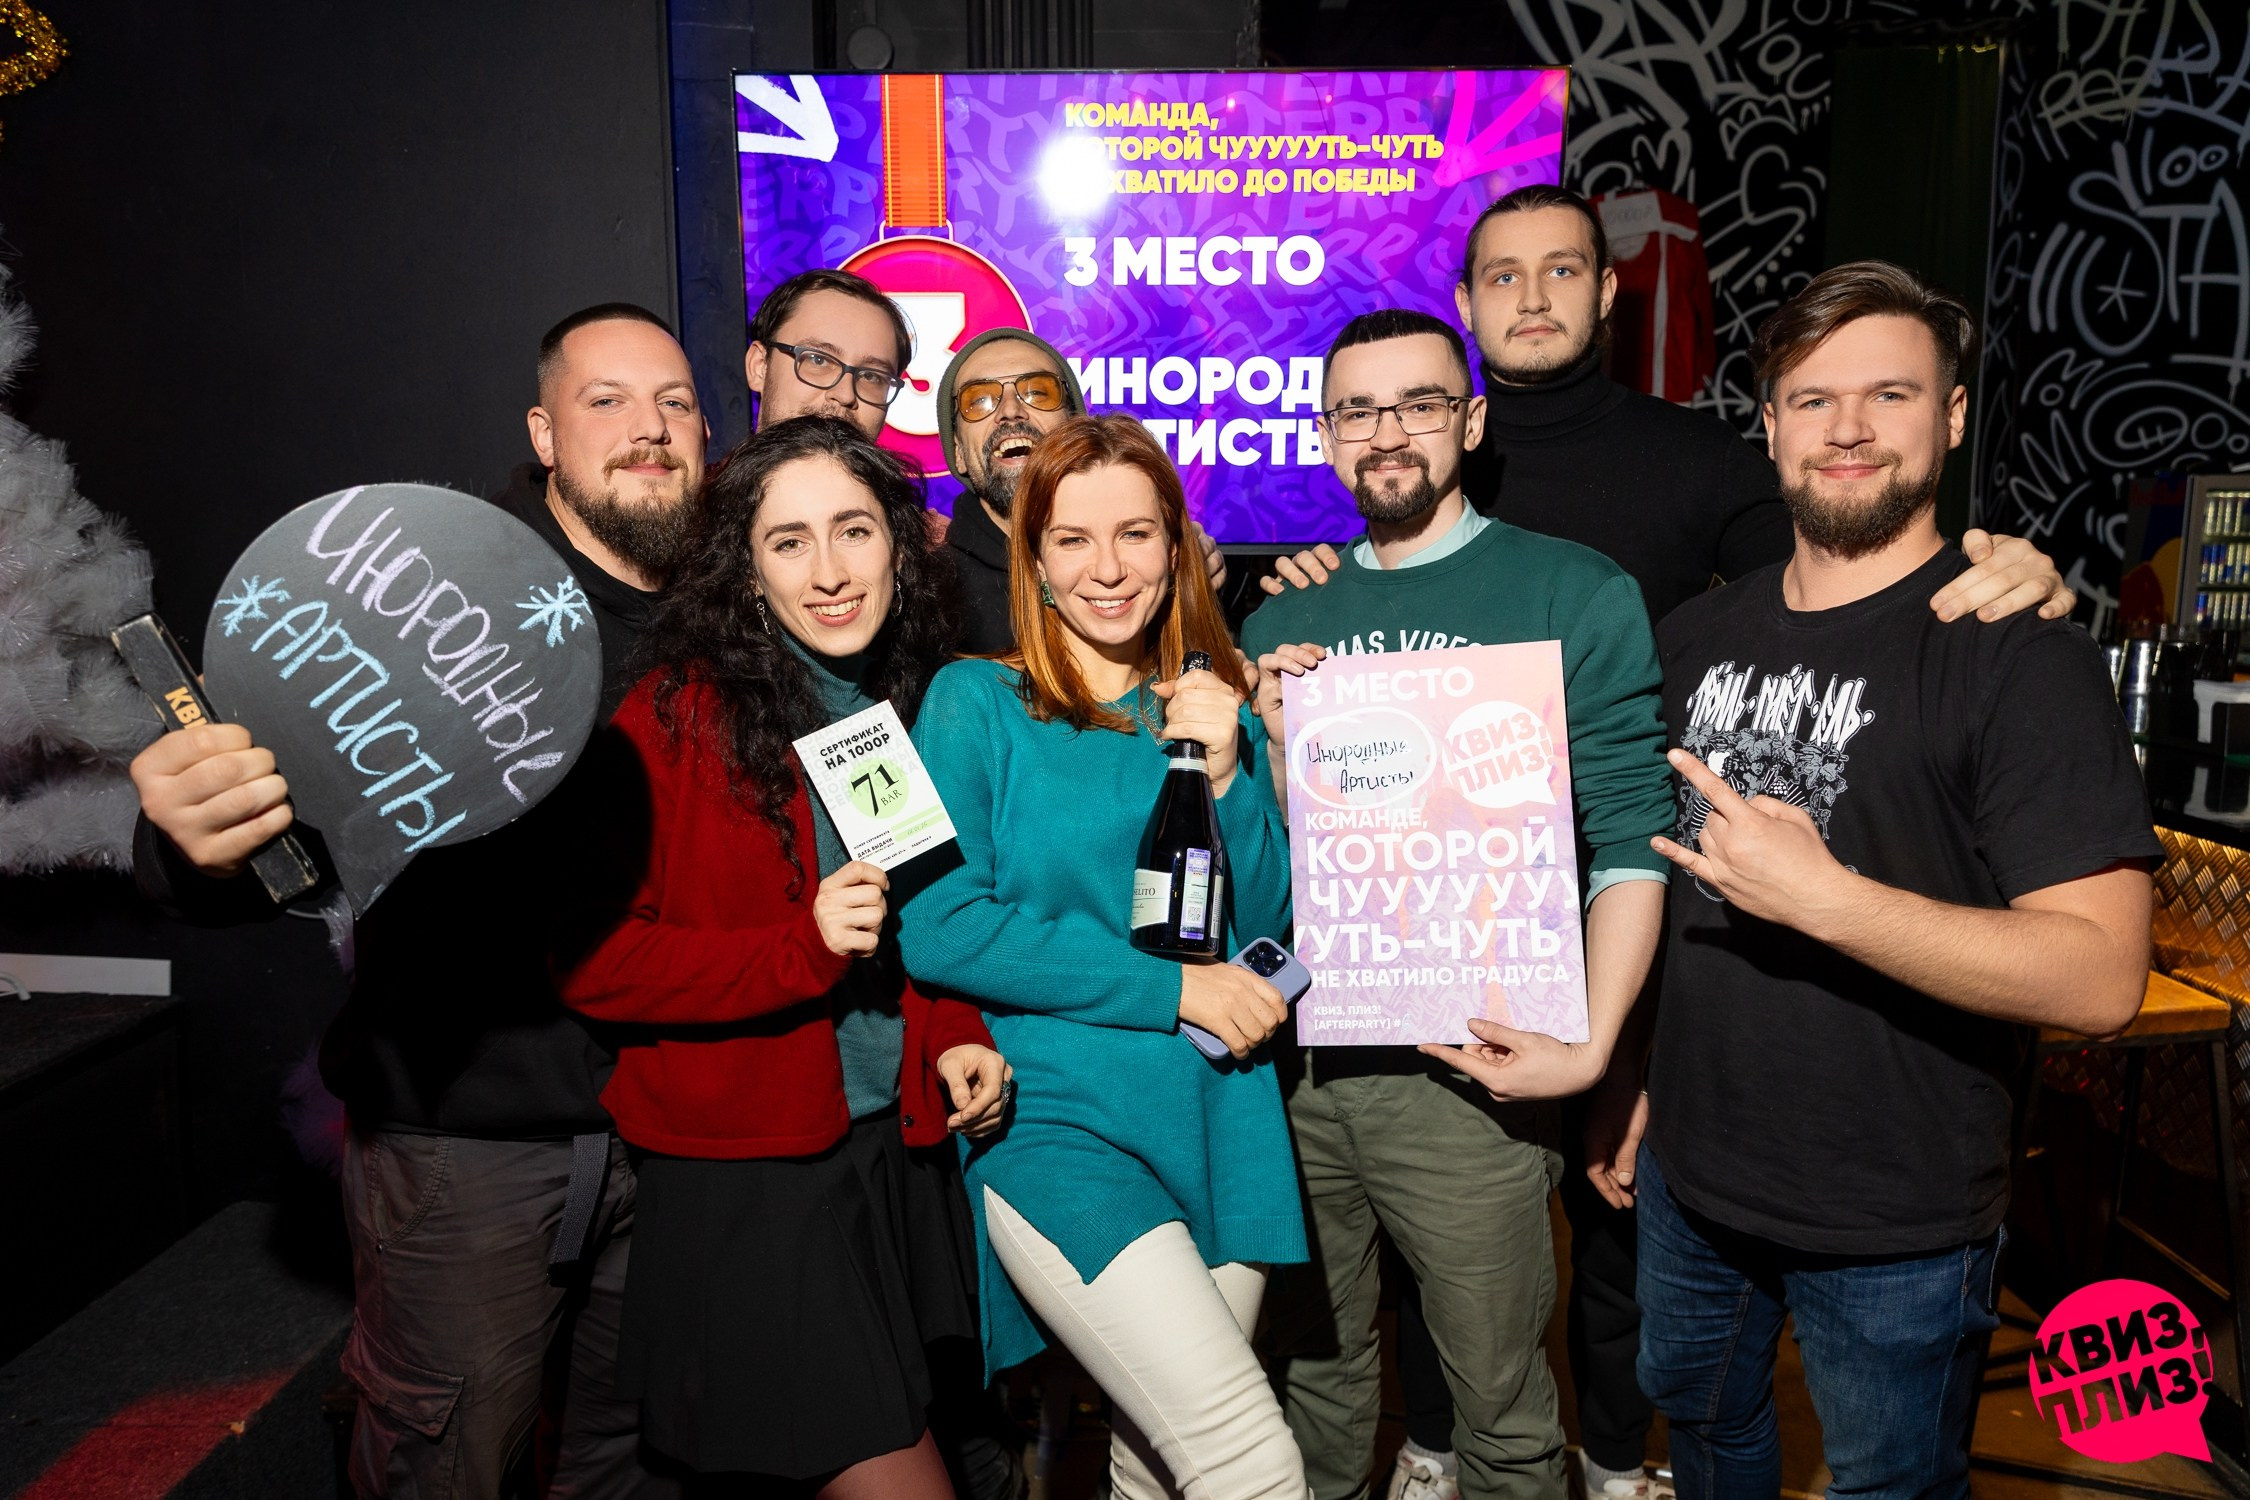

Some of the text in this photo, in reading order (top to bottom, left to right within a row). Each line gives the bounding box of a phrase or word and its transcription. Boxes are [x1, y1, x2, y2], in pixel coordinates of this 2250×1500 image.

[1065, 102, 1220, 131] КОМАНДА,
[1080, 129, 1204, 161] ТОРОЙ
[1243, 168, 1288, 197] ДО
[1293, 167, 1416, 196] ПОБЕДЫ
[1063, 235, 1326, 287] 3 МЕСТО
[1066, 355, 1325, 413] ИНОРОД
[1324, 630, 1385, 656] MAS
[1301, 665, 1475, 707] 3 МЕСТО
[250, 600, 468, 853] АРТИСТЫ
[820, 722, 885, 758] СЕРТИФИКАТ
[824, 755, 847, 771] НА
[851, 763, 900, 817] 71
[880, 788, 903, 806] BAR
[1305, 807, 1428, 833] КОМАНДЕ,
[1306, 815, 1557, 875] КОТОРОЙ
[1312, 964, 1571, 989] НЕ ХВАТИЛО ГРАДУСА
[1313, 1005, 1382, 1017] КВИЗ, ПЛИЗ!
[1314, 1018, 1391, 1031] [AFTERPARTY]
